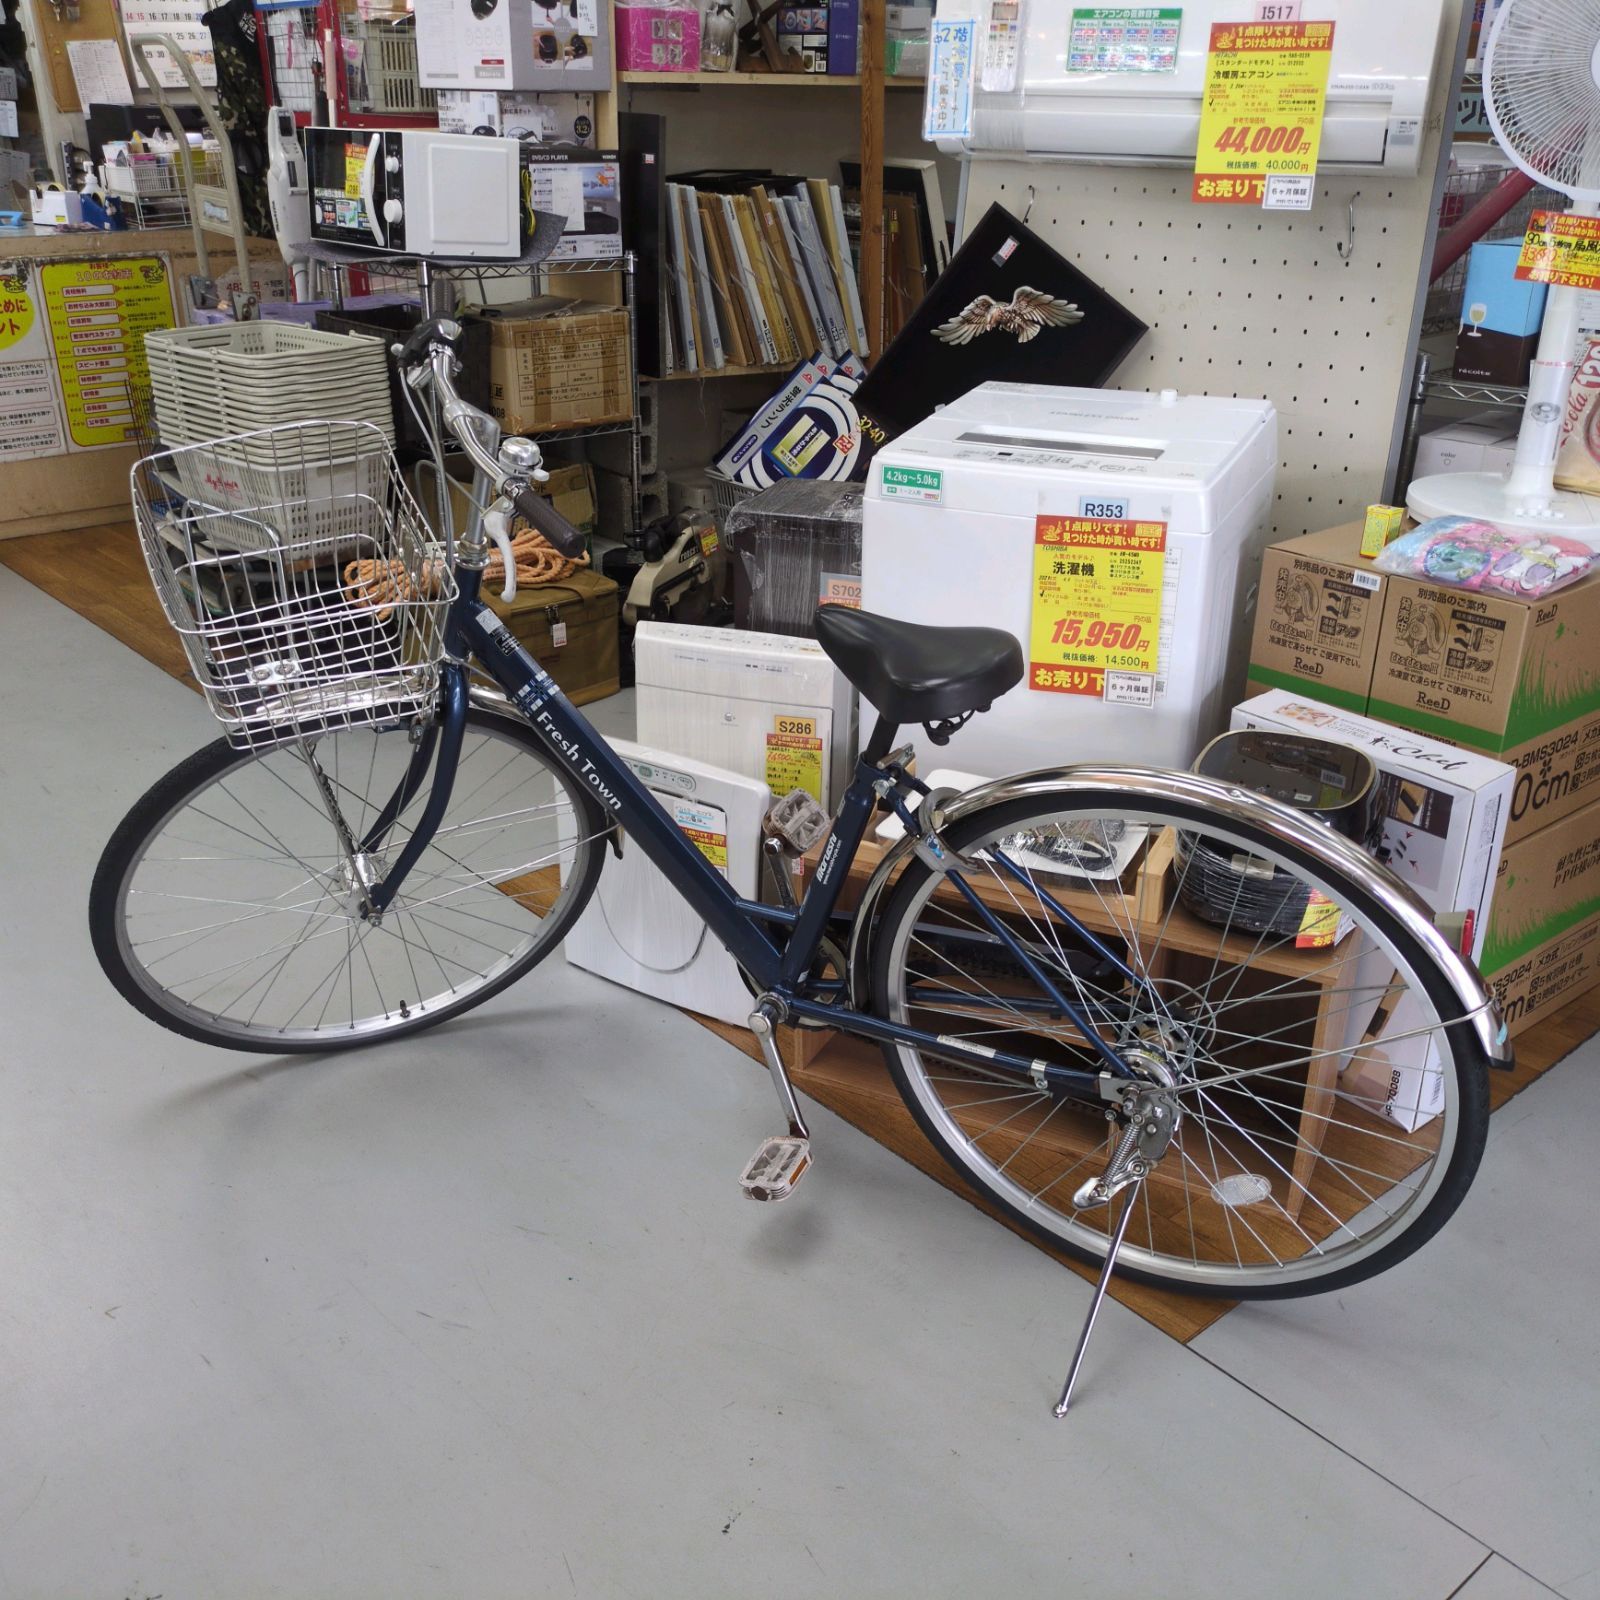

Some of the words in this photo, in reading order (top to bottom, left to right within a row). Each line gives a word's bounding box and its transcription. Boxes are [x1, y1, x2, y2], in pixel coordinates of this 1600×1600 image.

[126, 12, 133, 20] 14
[137, 12, 144, 20] 15
[148, 12, 156, 20] 16
[161, 12, 168, 20] 17
[173, 12, 180, 20] 18
[184, 12, 191, 20] 19
[1261, 6, 1293, 20] I517
[176, 32, 184, 40] 25
[187, 32, 196, 40] 26
[199, 32, 206, 40] 27
[1237, 25, 1298, 37] 1点限りです!
[1235, 37, 1329, 49] 見つけた時が買い時です!
[145, 50, 153, 58] 29
[156, 50, 165, 58] 30
[1213, 70, 1274, 80] 冷暖房エアコン
[1214, 126, 1311, 155] 44,000円
[1573, 238, 1600, 252] 扇風
[1085, 502, 1123, 518] R353
[1064, 520, 1128, 535] 1点限りです!
[1062, 532, 1161, 549] 見つけた時が買い時です!
[1052, 561, 1095, 577] 洗濯機
[1293, 559, 1354, 583] 別売品のご案内
[832, 584, 861, 598] S702
[1275, 567, 1290, 602] 発売中
[1418, 587, 1488, 613] 別売品のご案内
[1397, 596, 1412, 633] 発売中
[1536, 604, 1558, 624] ReeD
[1051, 618, 1150, 652] 15,950円
[1293, 656, 1325, 675] ReeD
[1388, 668, 1444, 690] 冷凍室で凍らせて
[1416, 691, 1451, 711] ReeD
[779, 721, 812, 735] S286
[1507, 730, 1579, 769] D-BMS3024
[536, 711, 580, 762] Fresh
[580, 758, 622, 810] Town
[1500, 995, 1525, 1023] m
